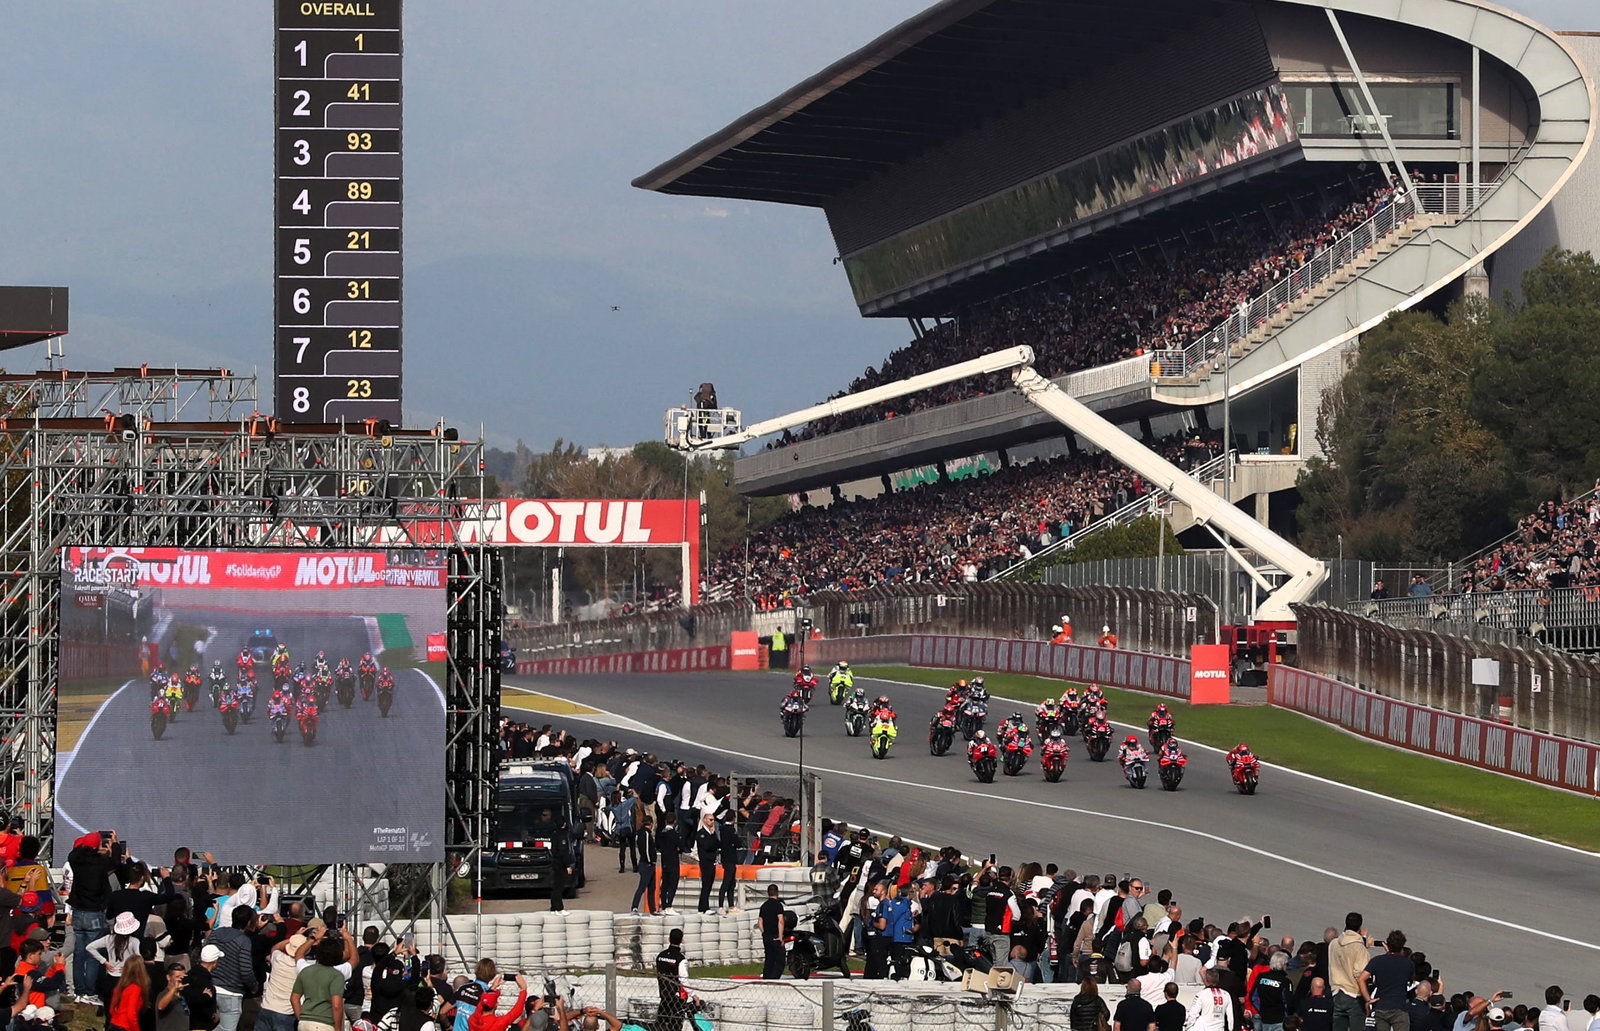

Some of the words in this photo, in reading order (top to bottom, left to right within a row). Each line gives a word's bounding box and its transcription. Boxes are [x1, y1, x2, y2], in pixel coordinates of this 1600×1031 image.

[300, 2, 375, 16] OVERALL
[294, 40, 307, 66] 1
[354, 33, 364, 51] 1
[292, 89, 311, 116] 2
[347, 83, 370, 101] 41
[293, 139, 311, 166] 3
[347, 132, 372, 150] 93
[292, 189, 311, 215] 4
[347, 182, 372, 200] 89
[293, 238, 311, 265] 5
[347, 231, 370, 249] 21
[293, 288, 311, 315] 6
[347, 281, 370, 299] 31
[292, 337, 311, 364] 7
[347, 330, 372, 348] 12
[292, 387, 310, 413] 8
[347, 379, 372, 398] 23
[458, 500, 652, 543] MOTUL
[74, 568, 102, 583] RACE
[105, 568, 138, 585] START
[294, 555, 378, 587] MOTUL
[1194, 670, 1227, 679] MOTUL
[1435, 714, 1455, 756] MOTUL
[1460, 720, 1481, 762] MOTUL
[1485, 726, 1506, 769] MOTUL
[1511, 732, 1533, 775] MOTUL
[1537, 738, 1560, 782] MOTUL
[1564, 744, 1588, 789] MOTUL
[1213, 996, 1223, 1006] 58
